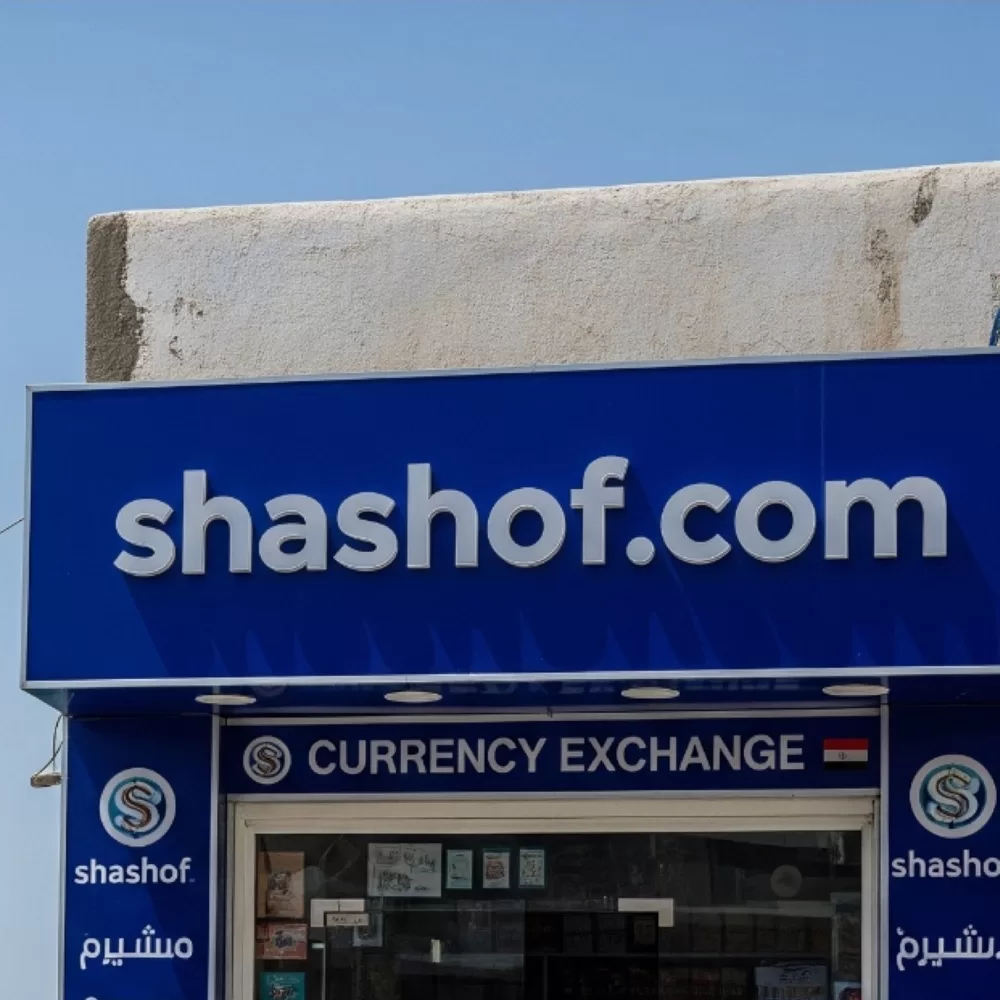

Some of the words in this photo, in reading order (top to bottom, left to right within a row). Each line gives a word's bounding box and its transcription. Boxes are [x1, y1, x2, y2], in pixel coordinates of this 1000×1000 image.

[113, 455, 948, 577] shashof.com
[308, 737, 547, 775] CURRENCY
[560, 734, 806, 773] EXCHANGE
